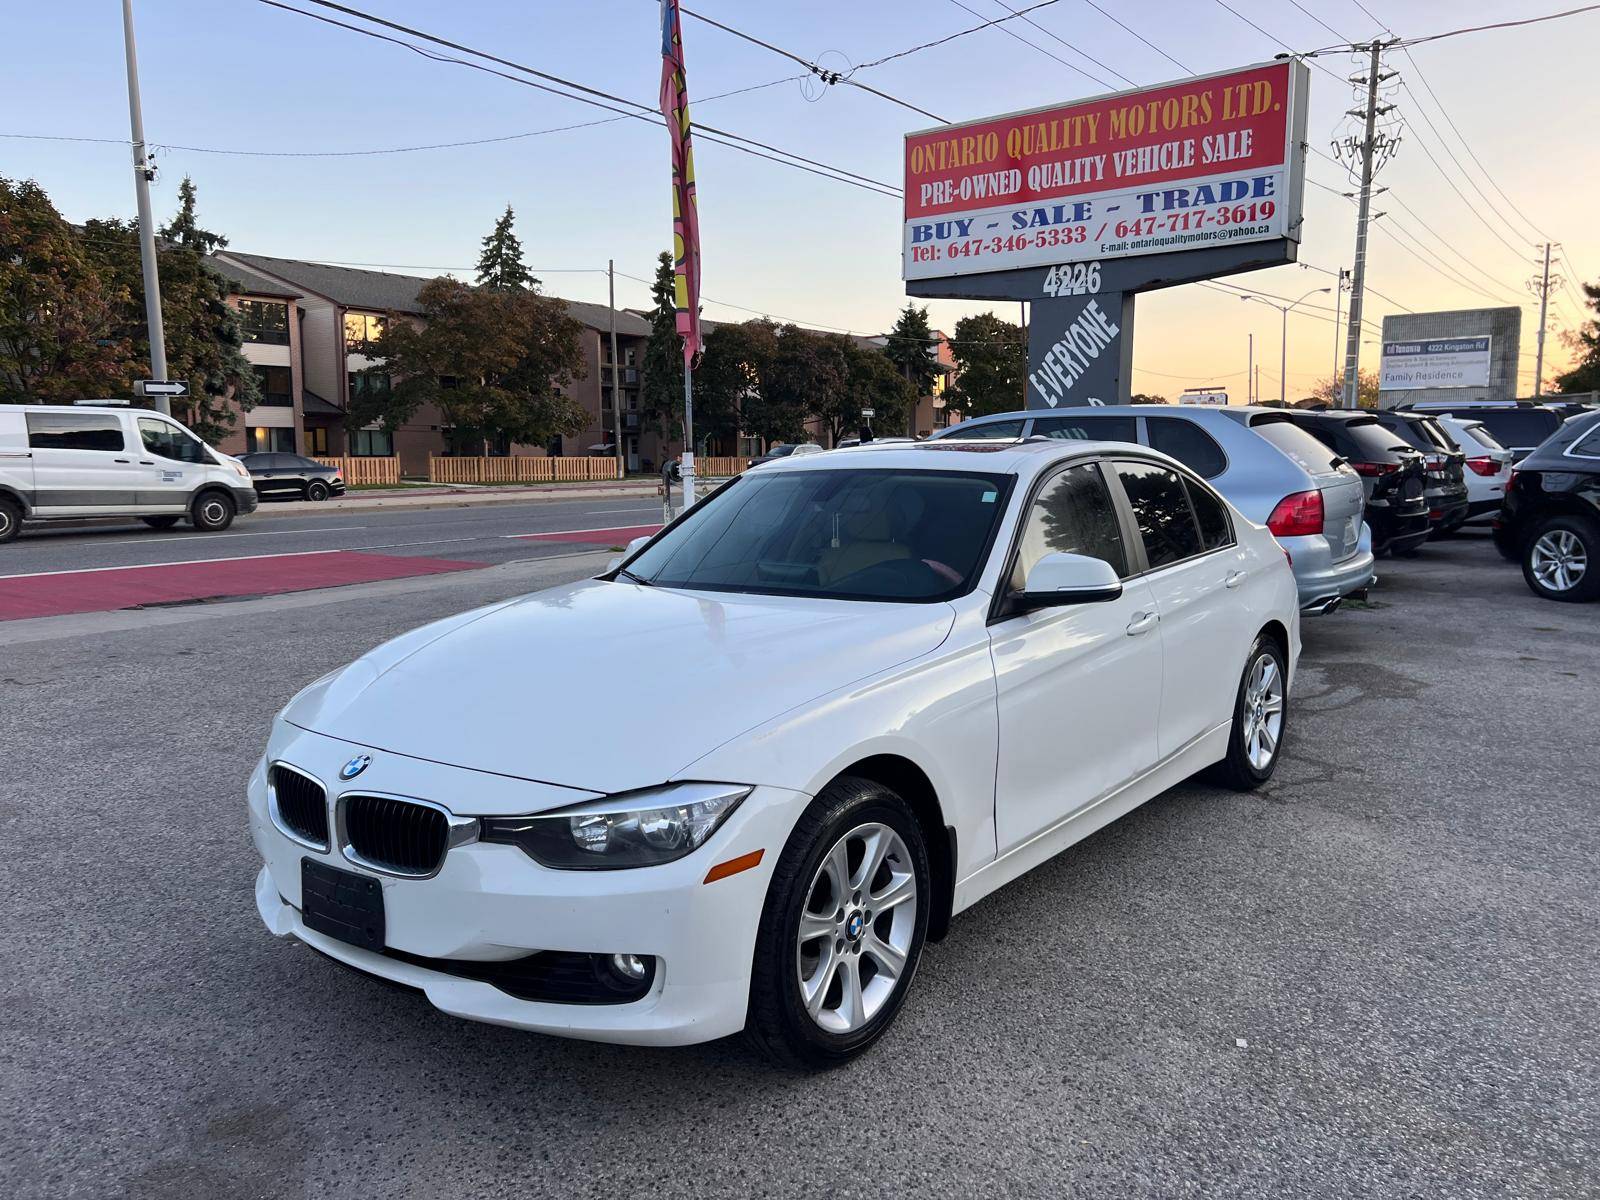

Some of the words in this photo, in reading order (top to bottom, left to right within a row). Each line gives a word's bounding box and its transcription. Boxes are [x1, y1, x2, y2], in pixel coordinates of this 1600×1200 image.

[911, 131, 999, 175] ONTARIO
[1006, 112, 1101, 161] QUALITY
[1109, 91, 1213, 141] MOTORS
[1222, 80, 1281, 121] LTD.
[920, 168, 1022, 208] PRE-OWNED
[1027, 154, 1106, 193] QUALITY
[1112, 138, 1195, 178] VEHICLE
[1202, 128, 1253, 164] SALE
[911, 218, 974, 243] BUY
[1011, 201, 1092, 230] SALE
[1136, 175, 1275, 214] TRADE
[911, 245, 941, 262] Tel:
[947, 225, 1087, 259] 647-346-5333
[1115, 200, 1275, 239] 647-717-3619
[1101, 242, 1129, 253] E-mail:
[1130, 224, 1270, 249] ontarioqualitymotors@yahoo.ca
[1043, 261, 1101, 297] 4226
[1029, 299, 1120, 408] EVERYONE
[1385, 373, 1413, 382] Family
[1415, 371, 1463, 380] Residence
[1444, 343, 1474, 352] Kingston
